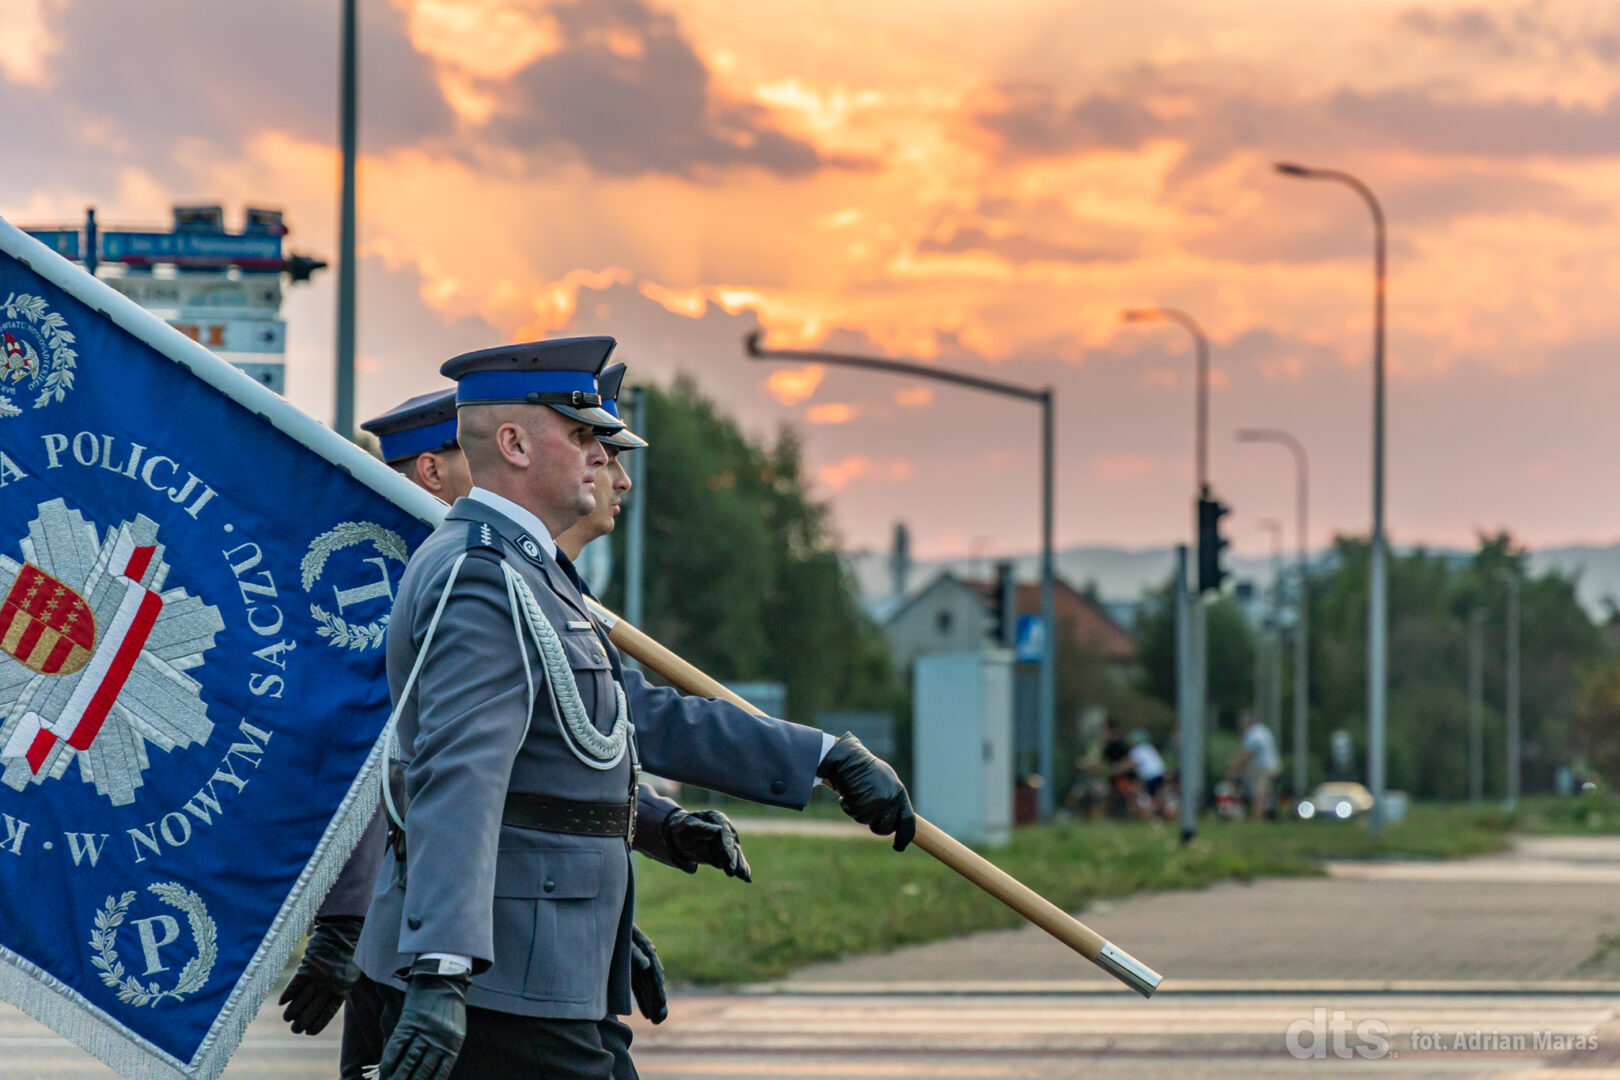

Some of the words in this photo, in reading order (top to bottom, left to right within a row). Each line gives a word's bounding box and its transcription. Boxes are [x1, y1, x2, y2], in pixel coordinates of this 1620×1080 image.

[41, 431, 219, 520] POLICJI
[333, 556, 394, 616] L
[64, 831, 109, 868] W
[126, 717, 273, 863] NOWYM
[222, 542, 297, 699] SĄCZU
[130, 914, 180, 977] P
